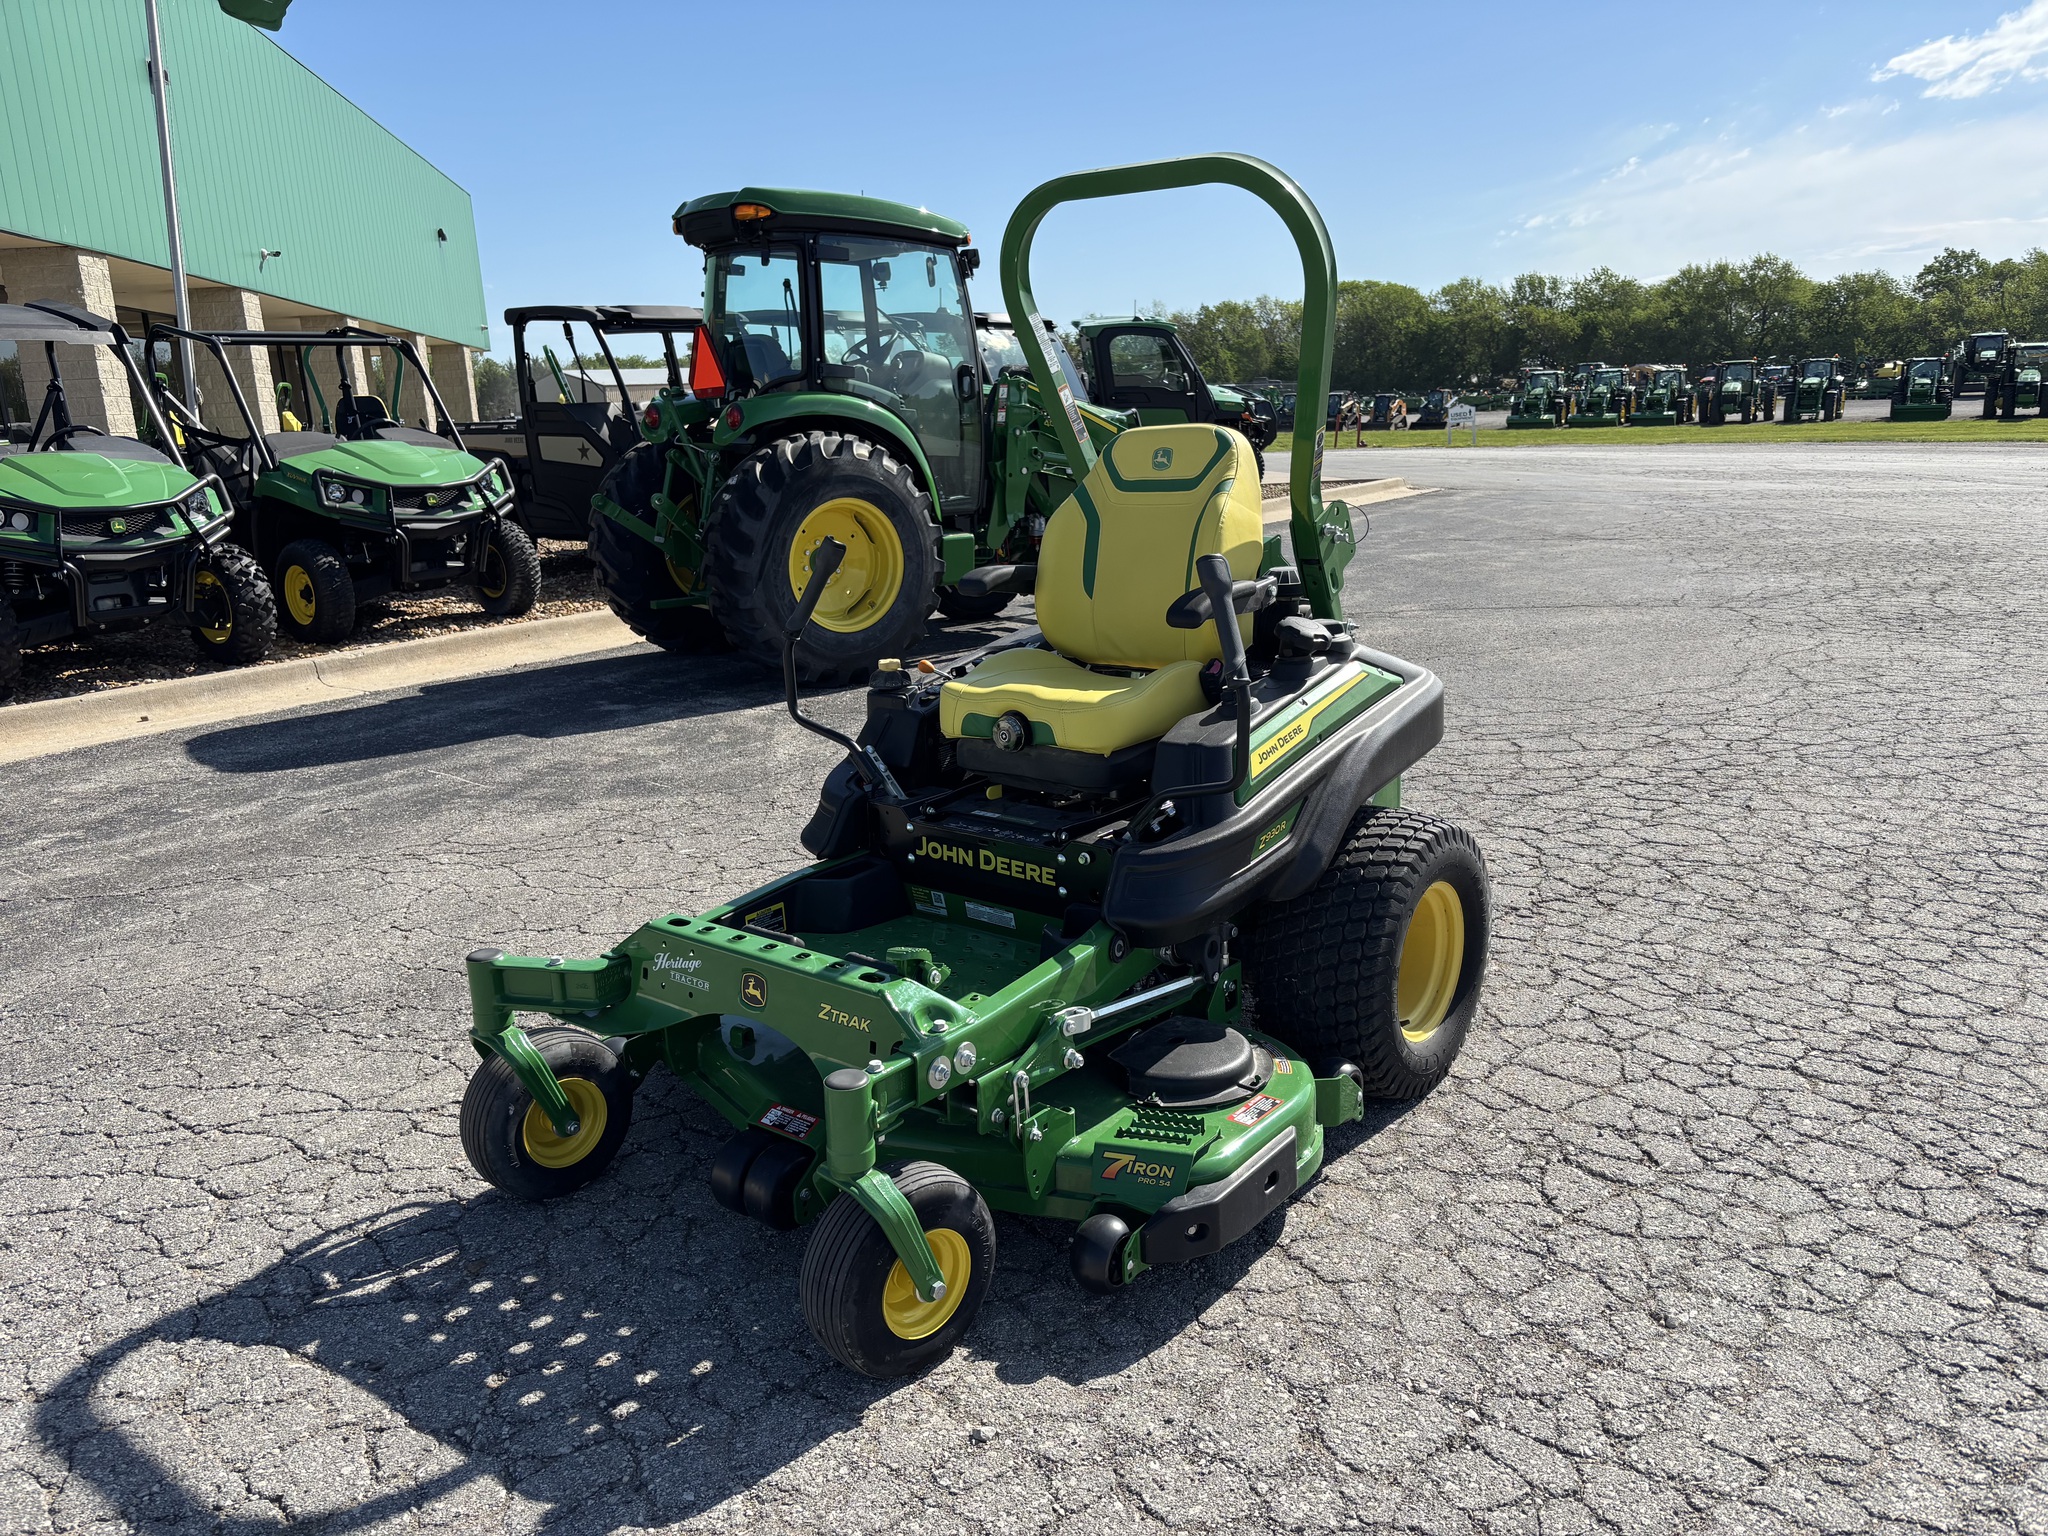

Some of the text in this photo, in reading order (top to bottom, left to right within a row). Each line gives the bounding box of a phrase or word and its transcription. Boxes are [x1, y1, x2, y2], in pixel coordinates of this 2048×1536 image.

[1258, 724, 1304, 765] JOHN DEERE
[1258, 820, 1287, 850] Z930R
[916, 836, 1056, 887] JOHN DEERE
[652, 952, 703, 972] Heritage
[670, 971, 710, 990] TRACTOR
[818, 1003, 871, 1033] ZTRAK
[1137, 1177, 1156, 1185] PRO
